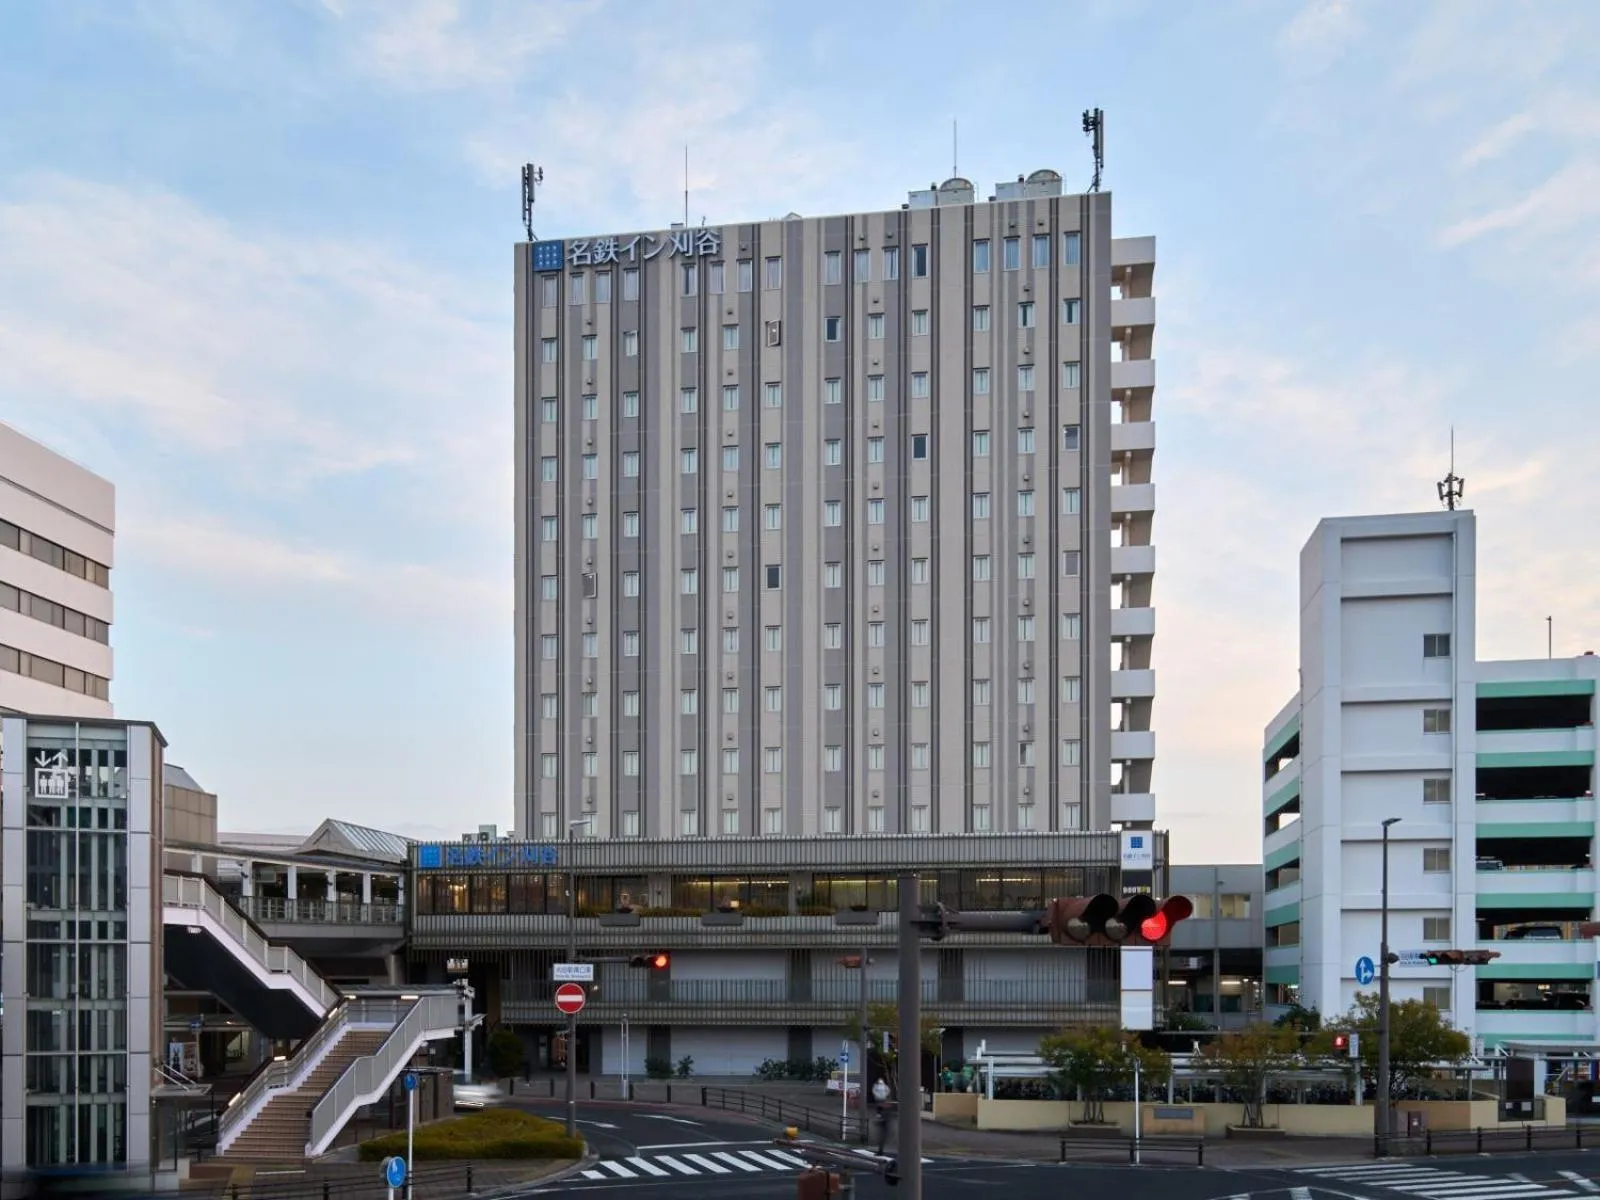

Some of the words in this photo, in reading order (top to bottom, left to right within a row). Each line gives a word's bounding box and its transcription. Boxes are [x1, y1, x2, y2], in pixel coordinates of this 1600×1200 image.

[567, 230, 721, 266] 名鉄イン刈谷
